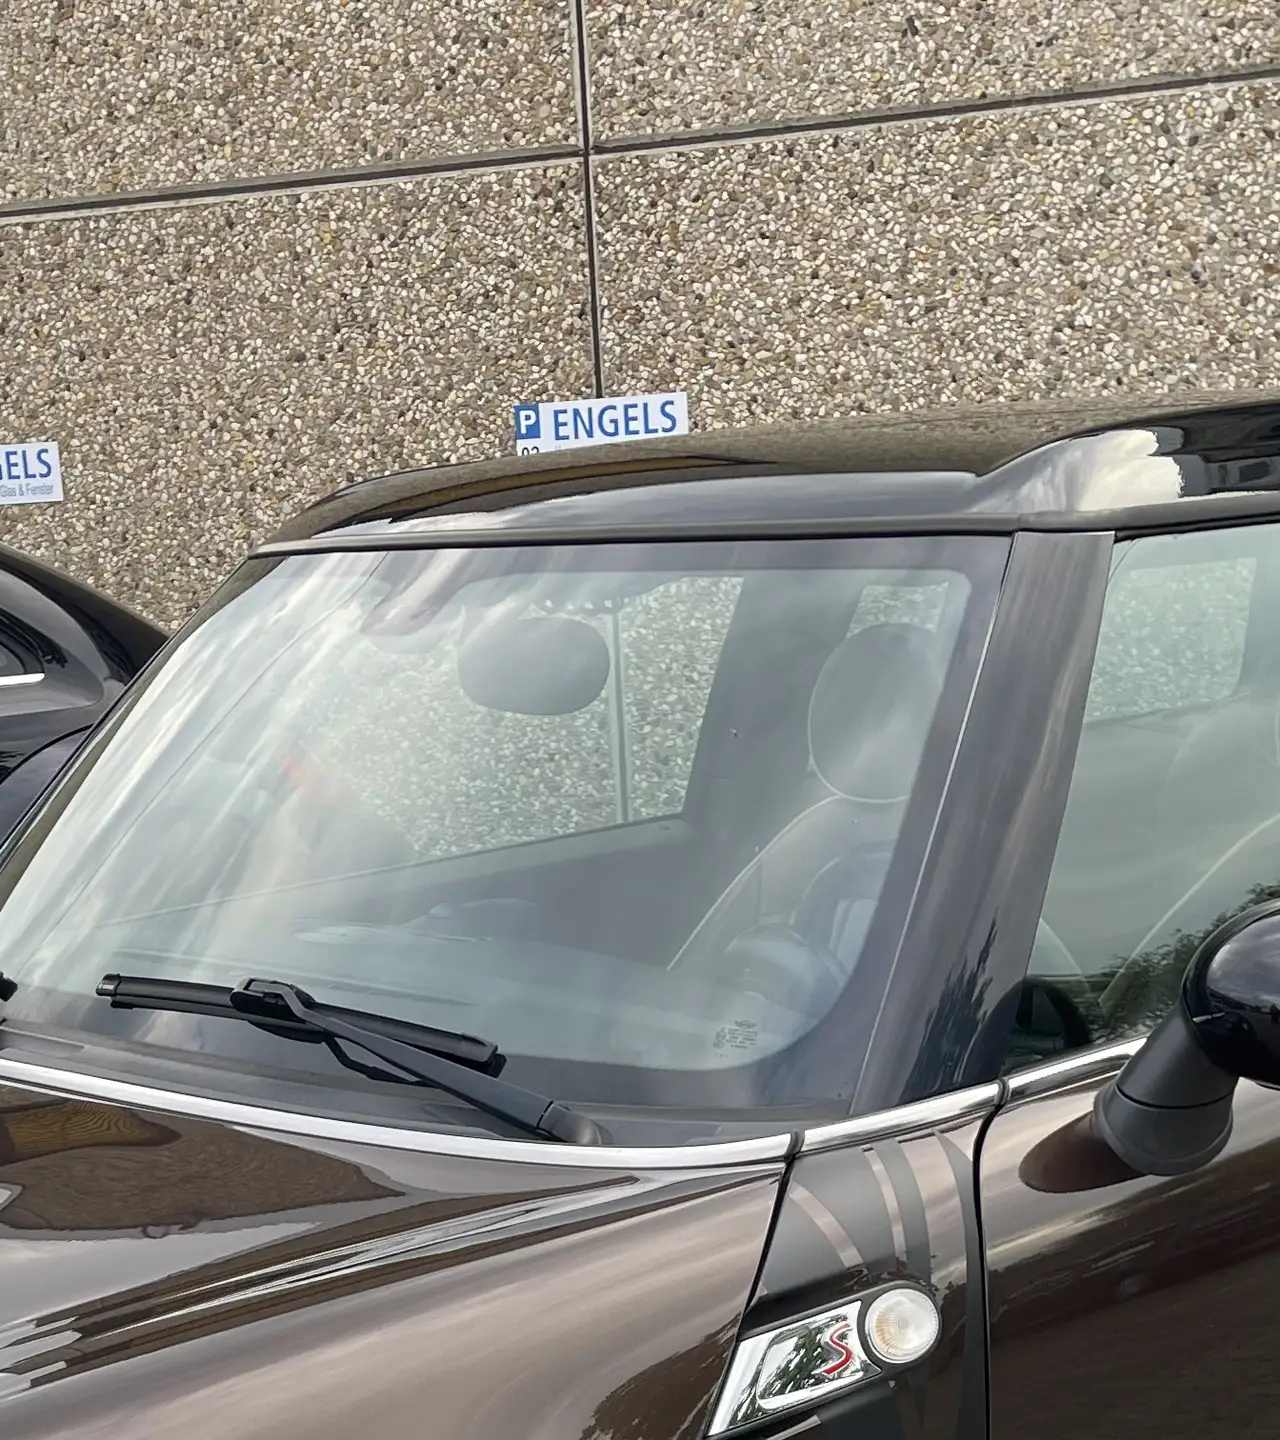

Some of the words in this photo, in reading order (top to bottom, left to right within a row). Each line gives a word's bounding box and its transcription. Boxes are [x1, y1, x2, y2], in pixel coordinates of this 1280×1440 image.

[520, 410, 537, 434] P
[553, 400, 677, 441] ENGELS
[0, 484, 17, 498] Glas
